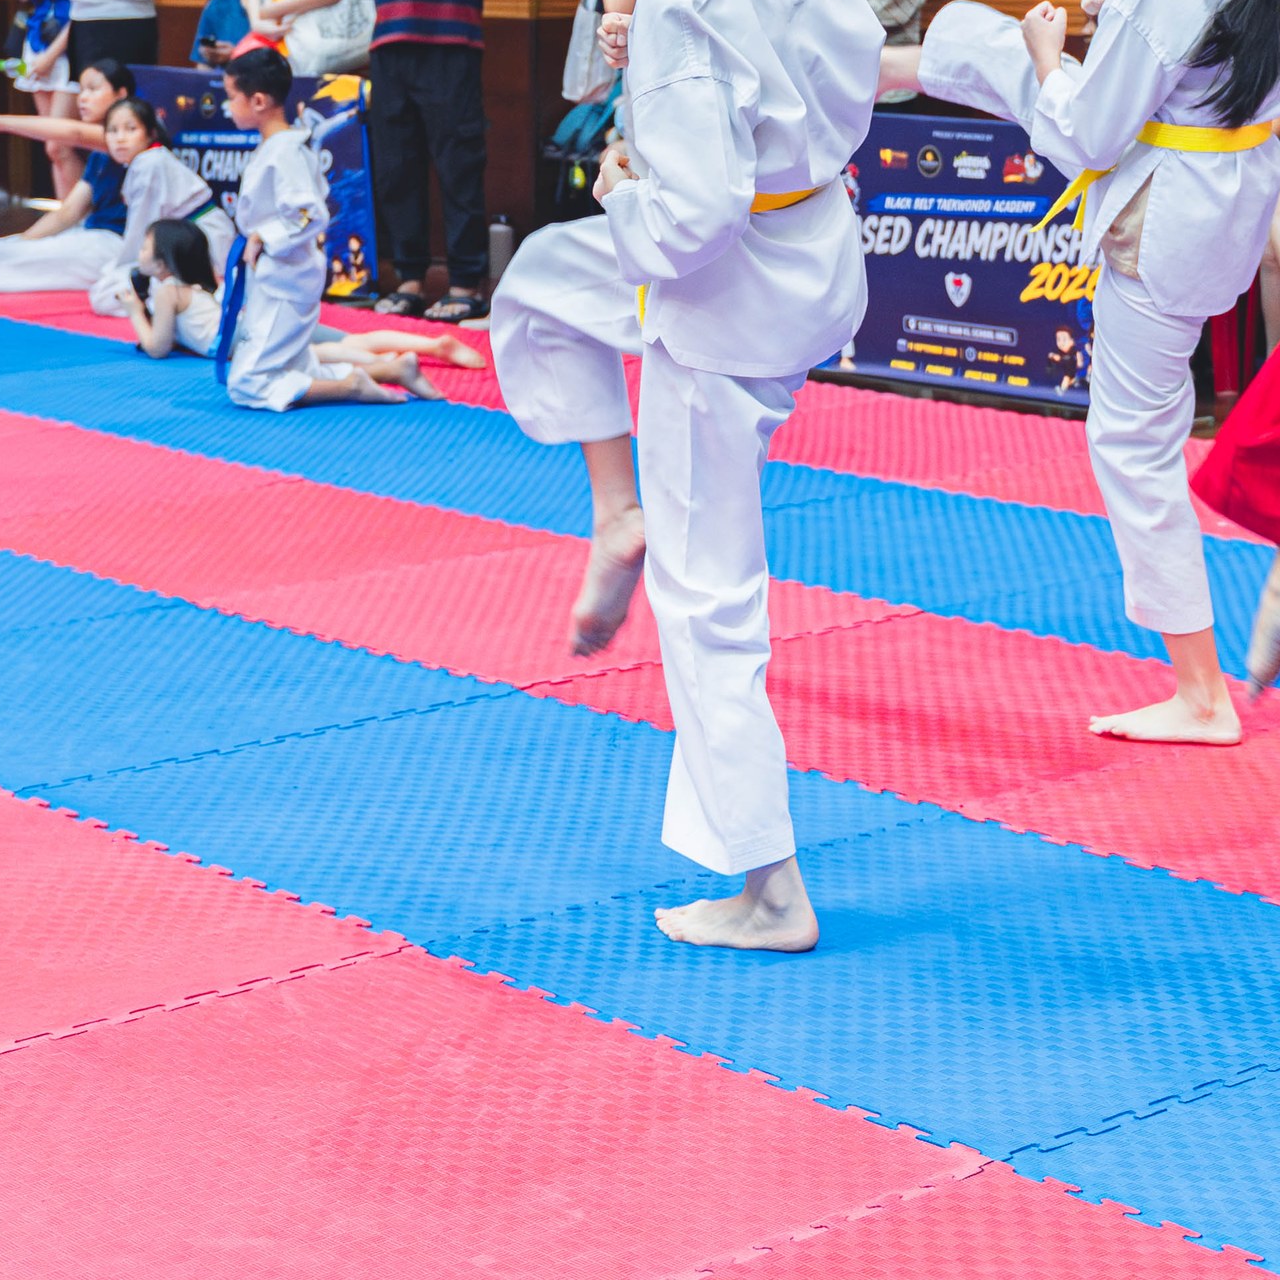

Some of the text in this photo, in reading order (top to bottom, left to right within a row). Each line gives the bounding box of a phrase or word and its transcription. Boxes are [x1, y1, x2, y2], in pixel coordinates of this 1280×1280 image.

[884, 196, 1037, 214] BLACK BELT TAEKWONDO ACADEMY
[856, 214, 1104, 268] SED CHAMPIONSH
